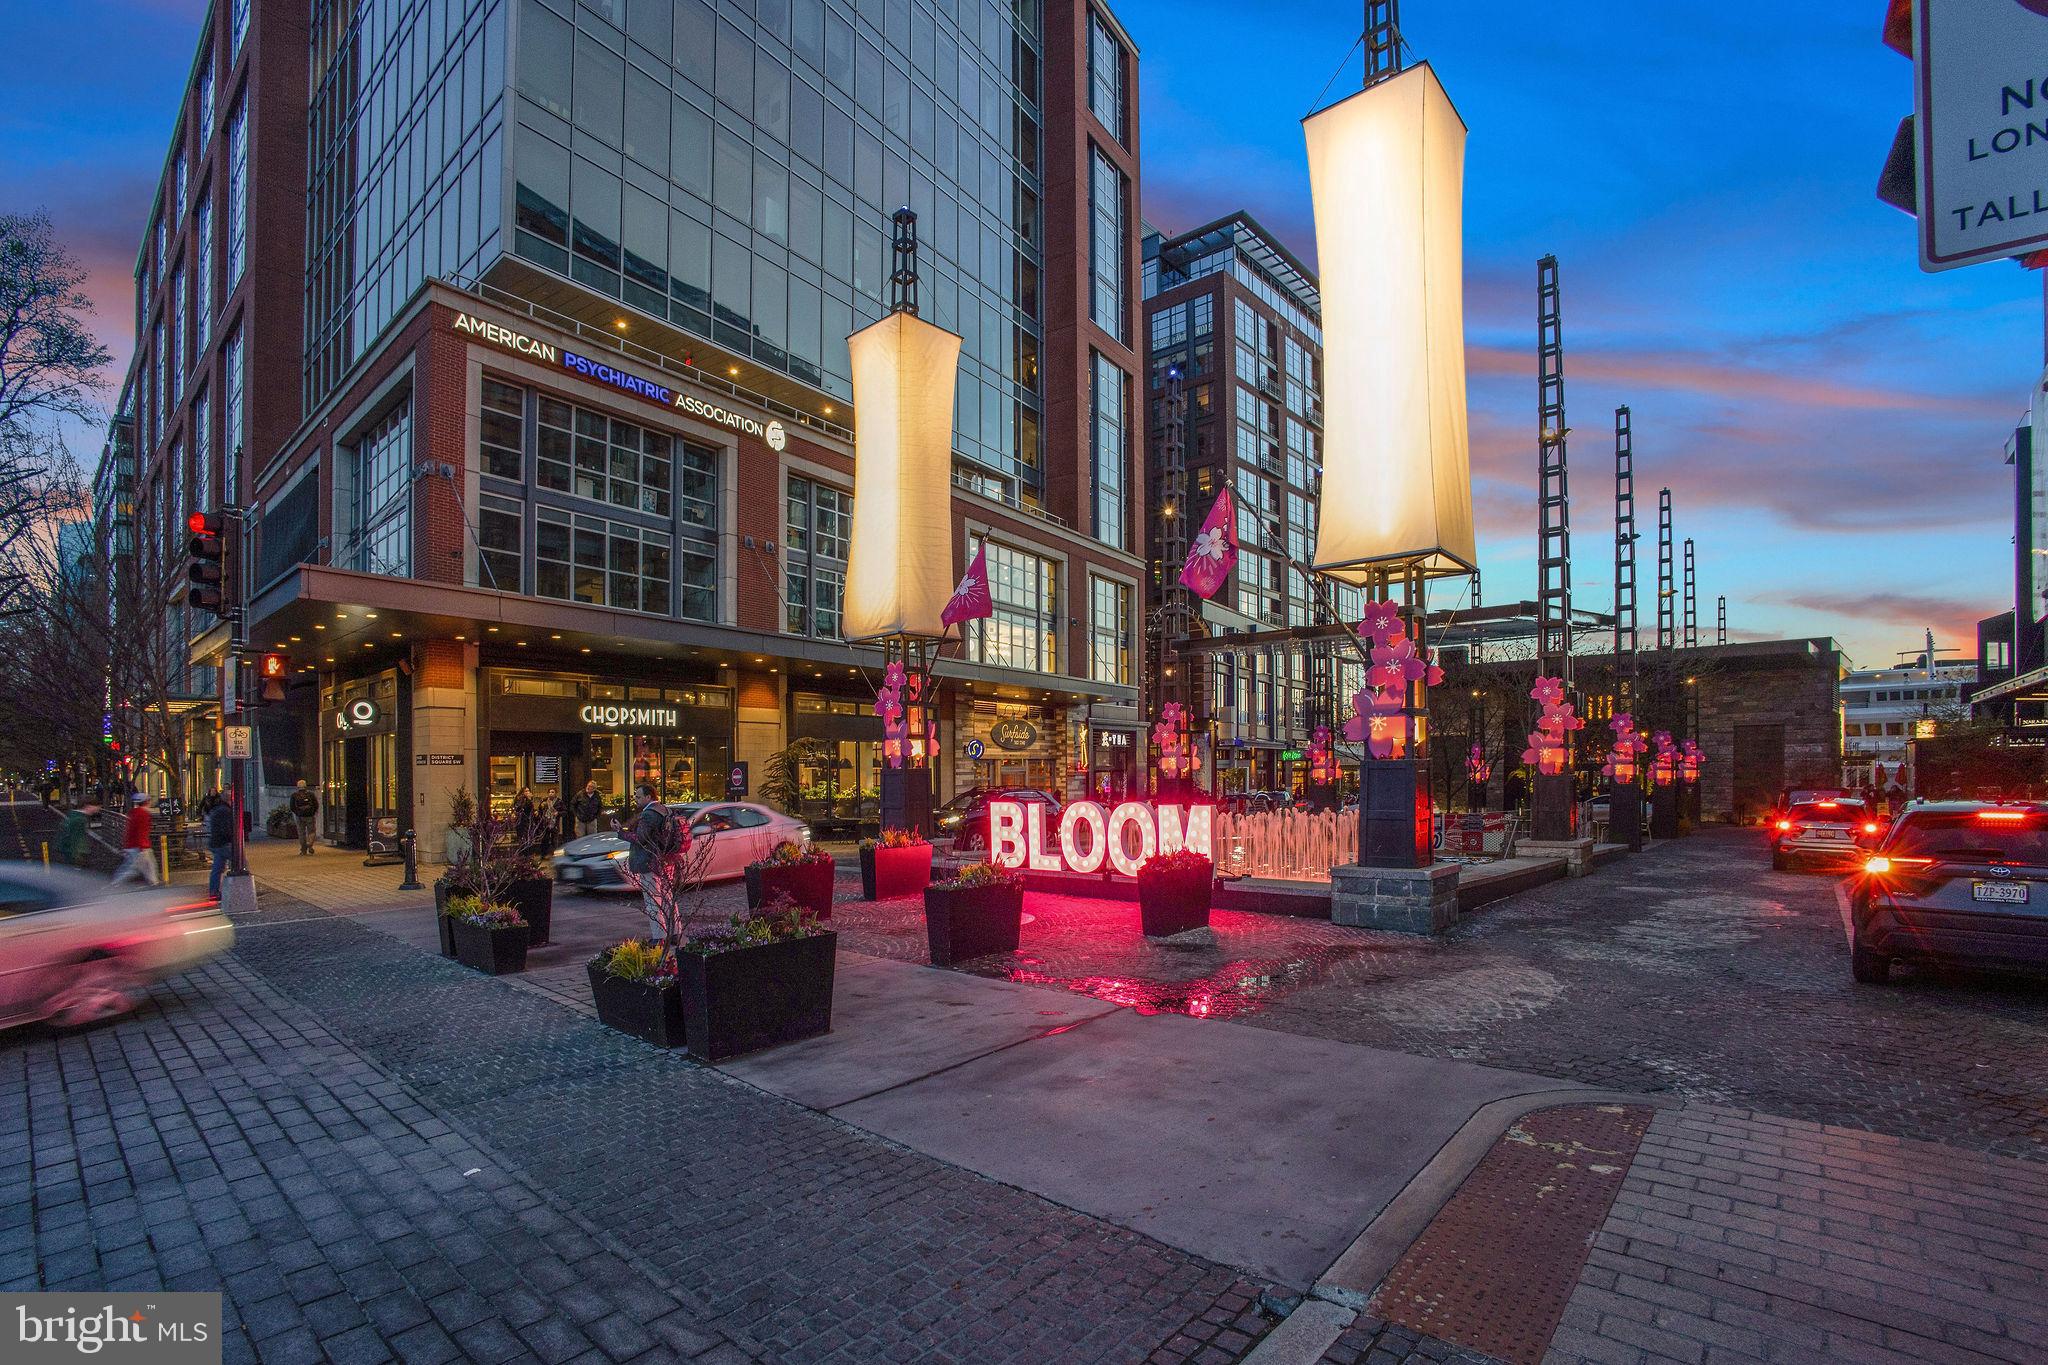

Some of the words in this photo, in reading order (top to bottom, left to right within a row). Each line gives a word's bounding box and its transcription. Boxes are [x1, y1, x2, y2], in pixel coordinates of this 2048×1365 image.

[1952, 189, 2048, 231] TALL
[454, 314, 555, 362] AMERICAN
[564, 352, 670, 403] PSYCHIATRIC
[675, 394, 764, 437] ASSOCIATION
[581, 705, 676, 726] CHOPSMITH
[1000, 724, 1030, 742] Surfside
[990, 801, 1216, 877] BLOOM
[1976, 887, 2025, 899] TZP-3970
